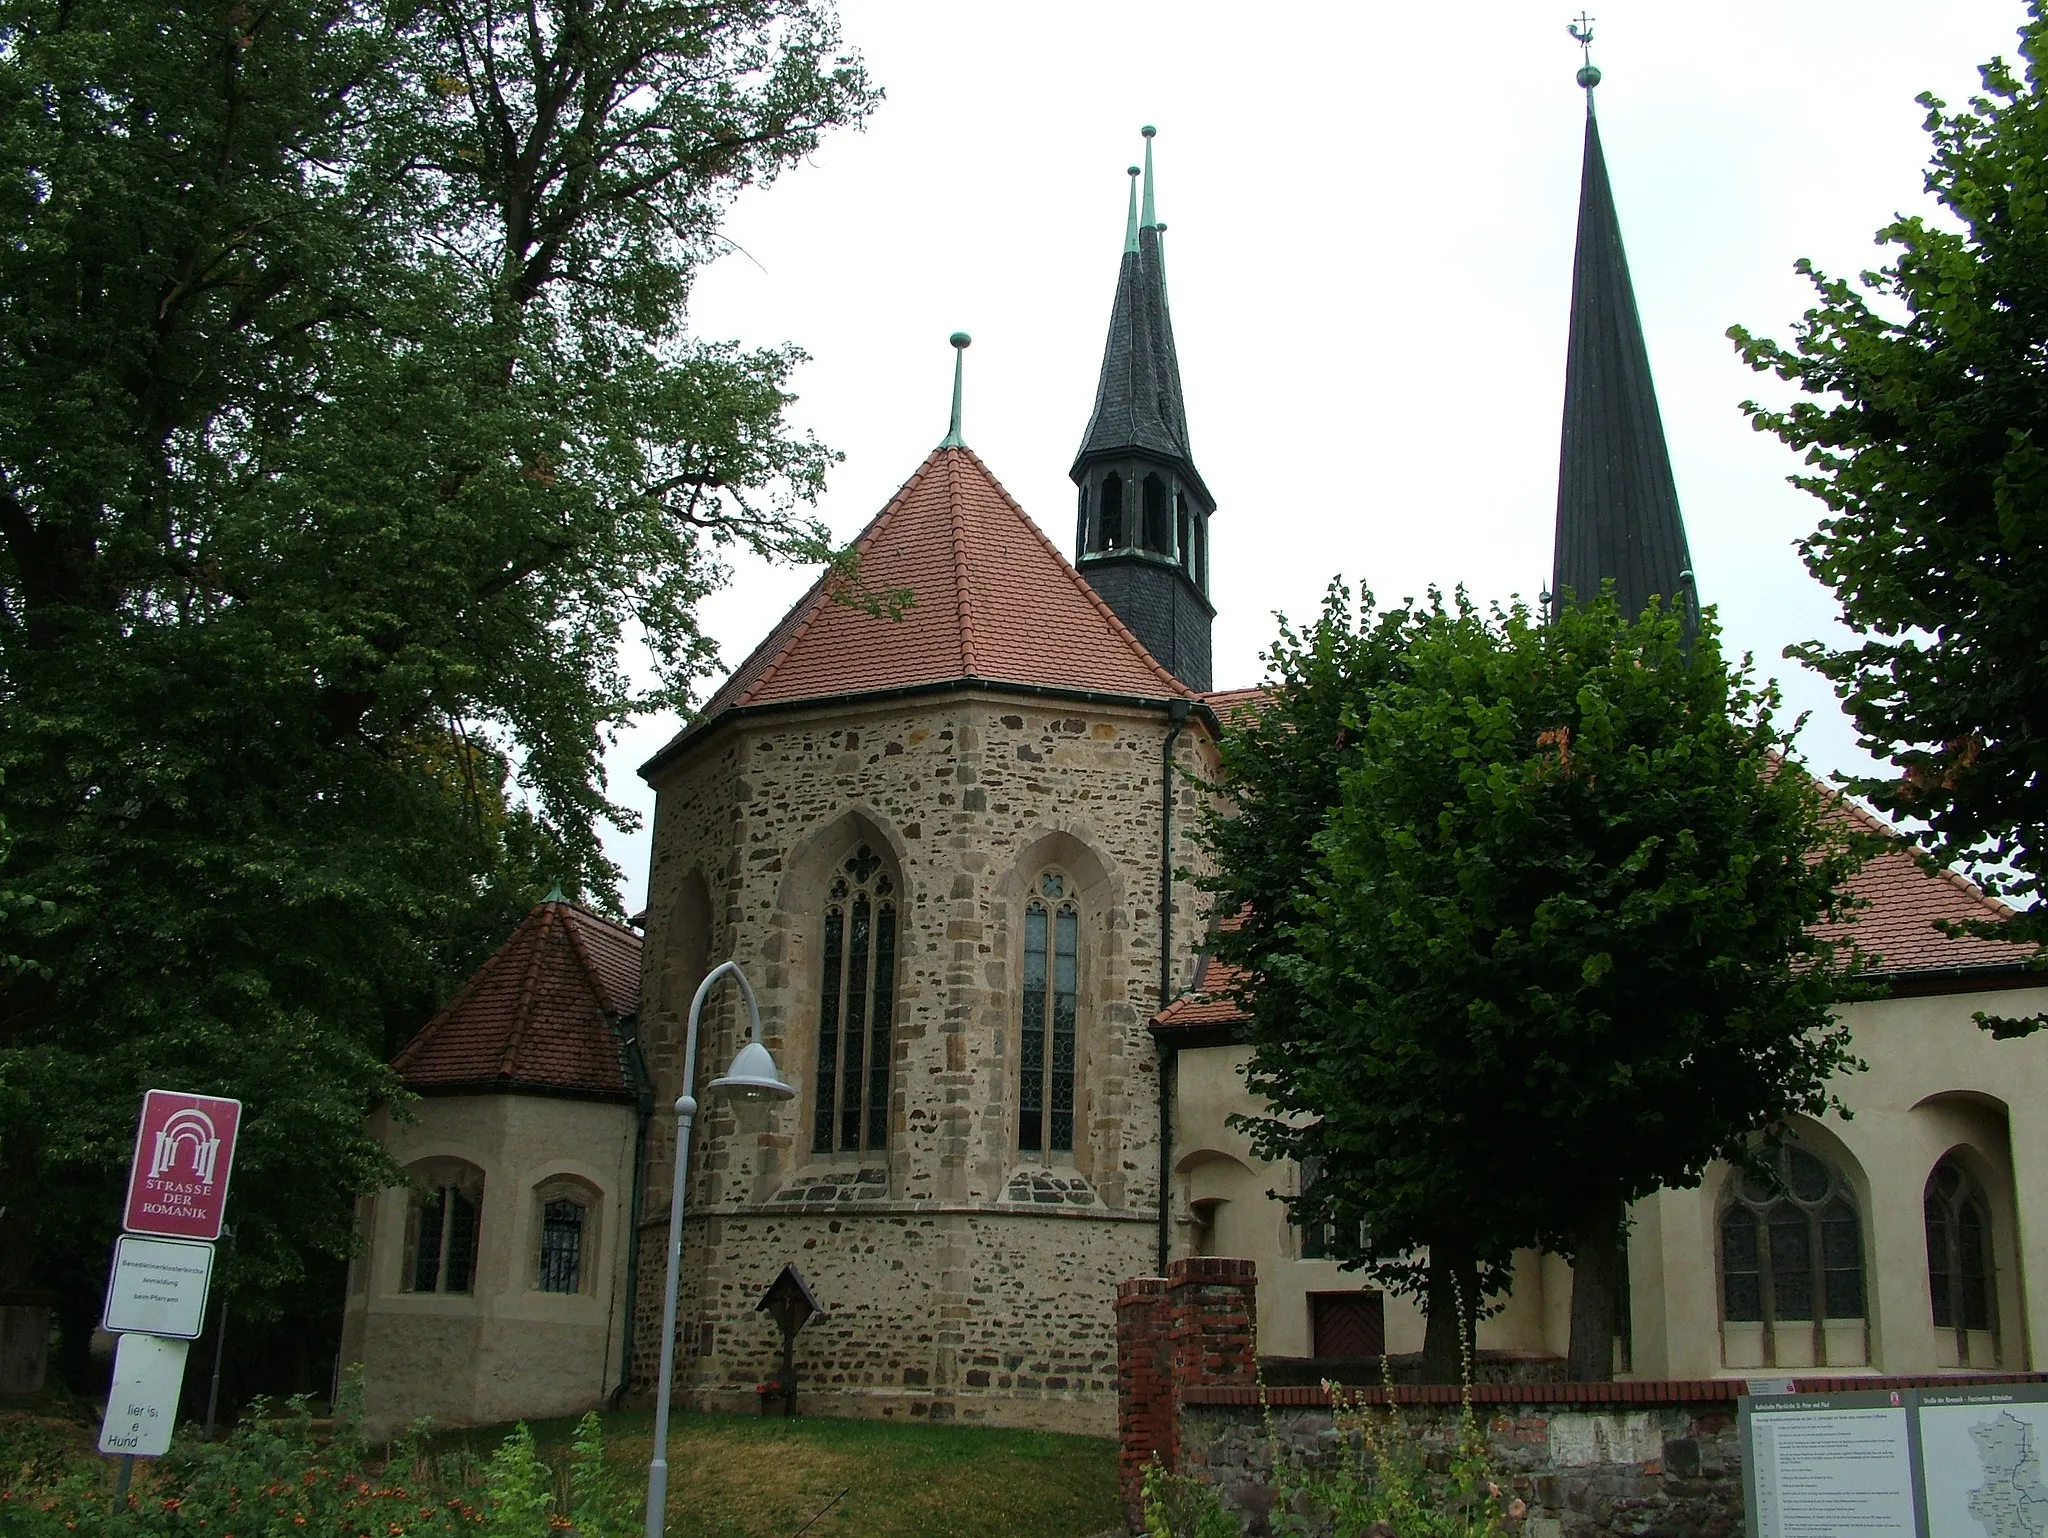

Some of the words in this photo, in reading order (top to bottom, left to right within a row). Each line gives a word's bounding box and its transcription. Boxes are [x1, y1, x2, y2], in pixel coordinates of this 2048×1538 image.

[146, 1179, 212, 1196] STRASSE
[163, 1193, 192, 1205] DER
[143, 1202, 207, 1219] ROMANIK
[142, 1277, 179, 1288] Anmeldung
